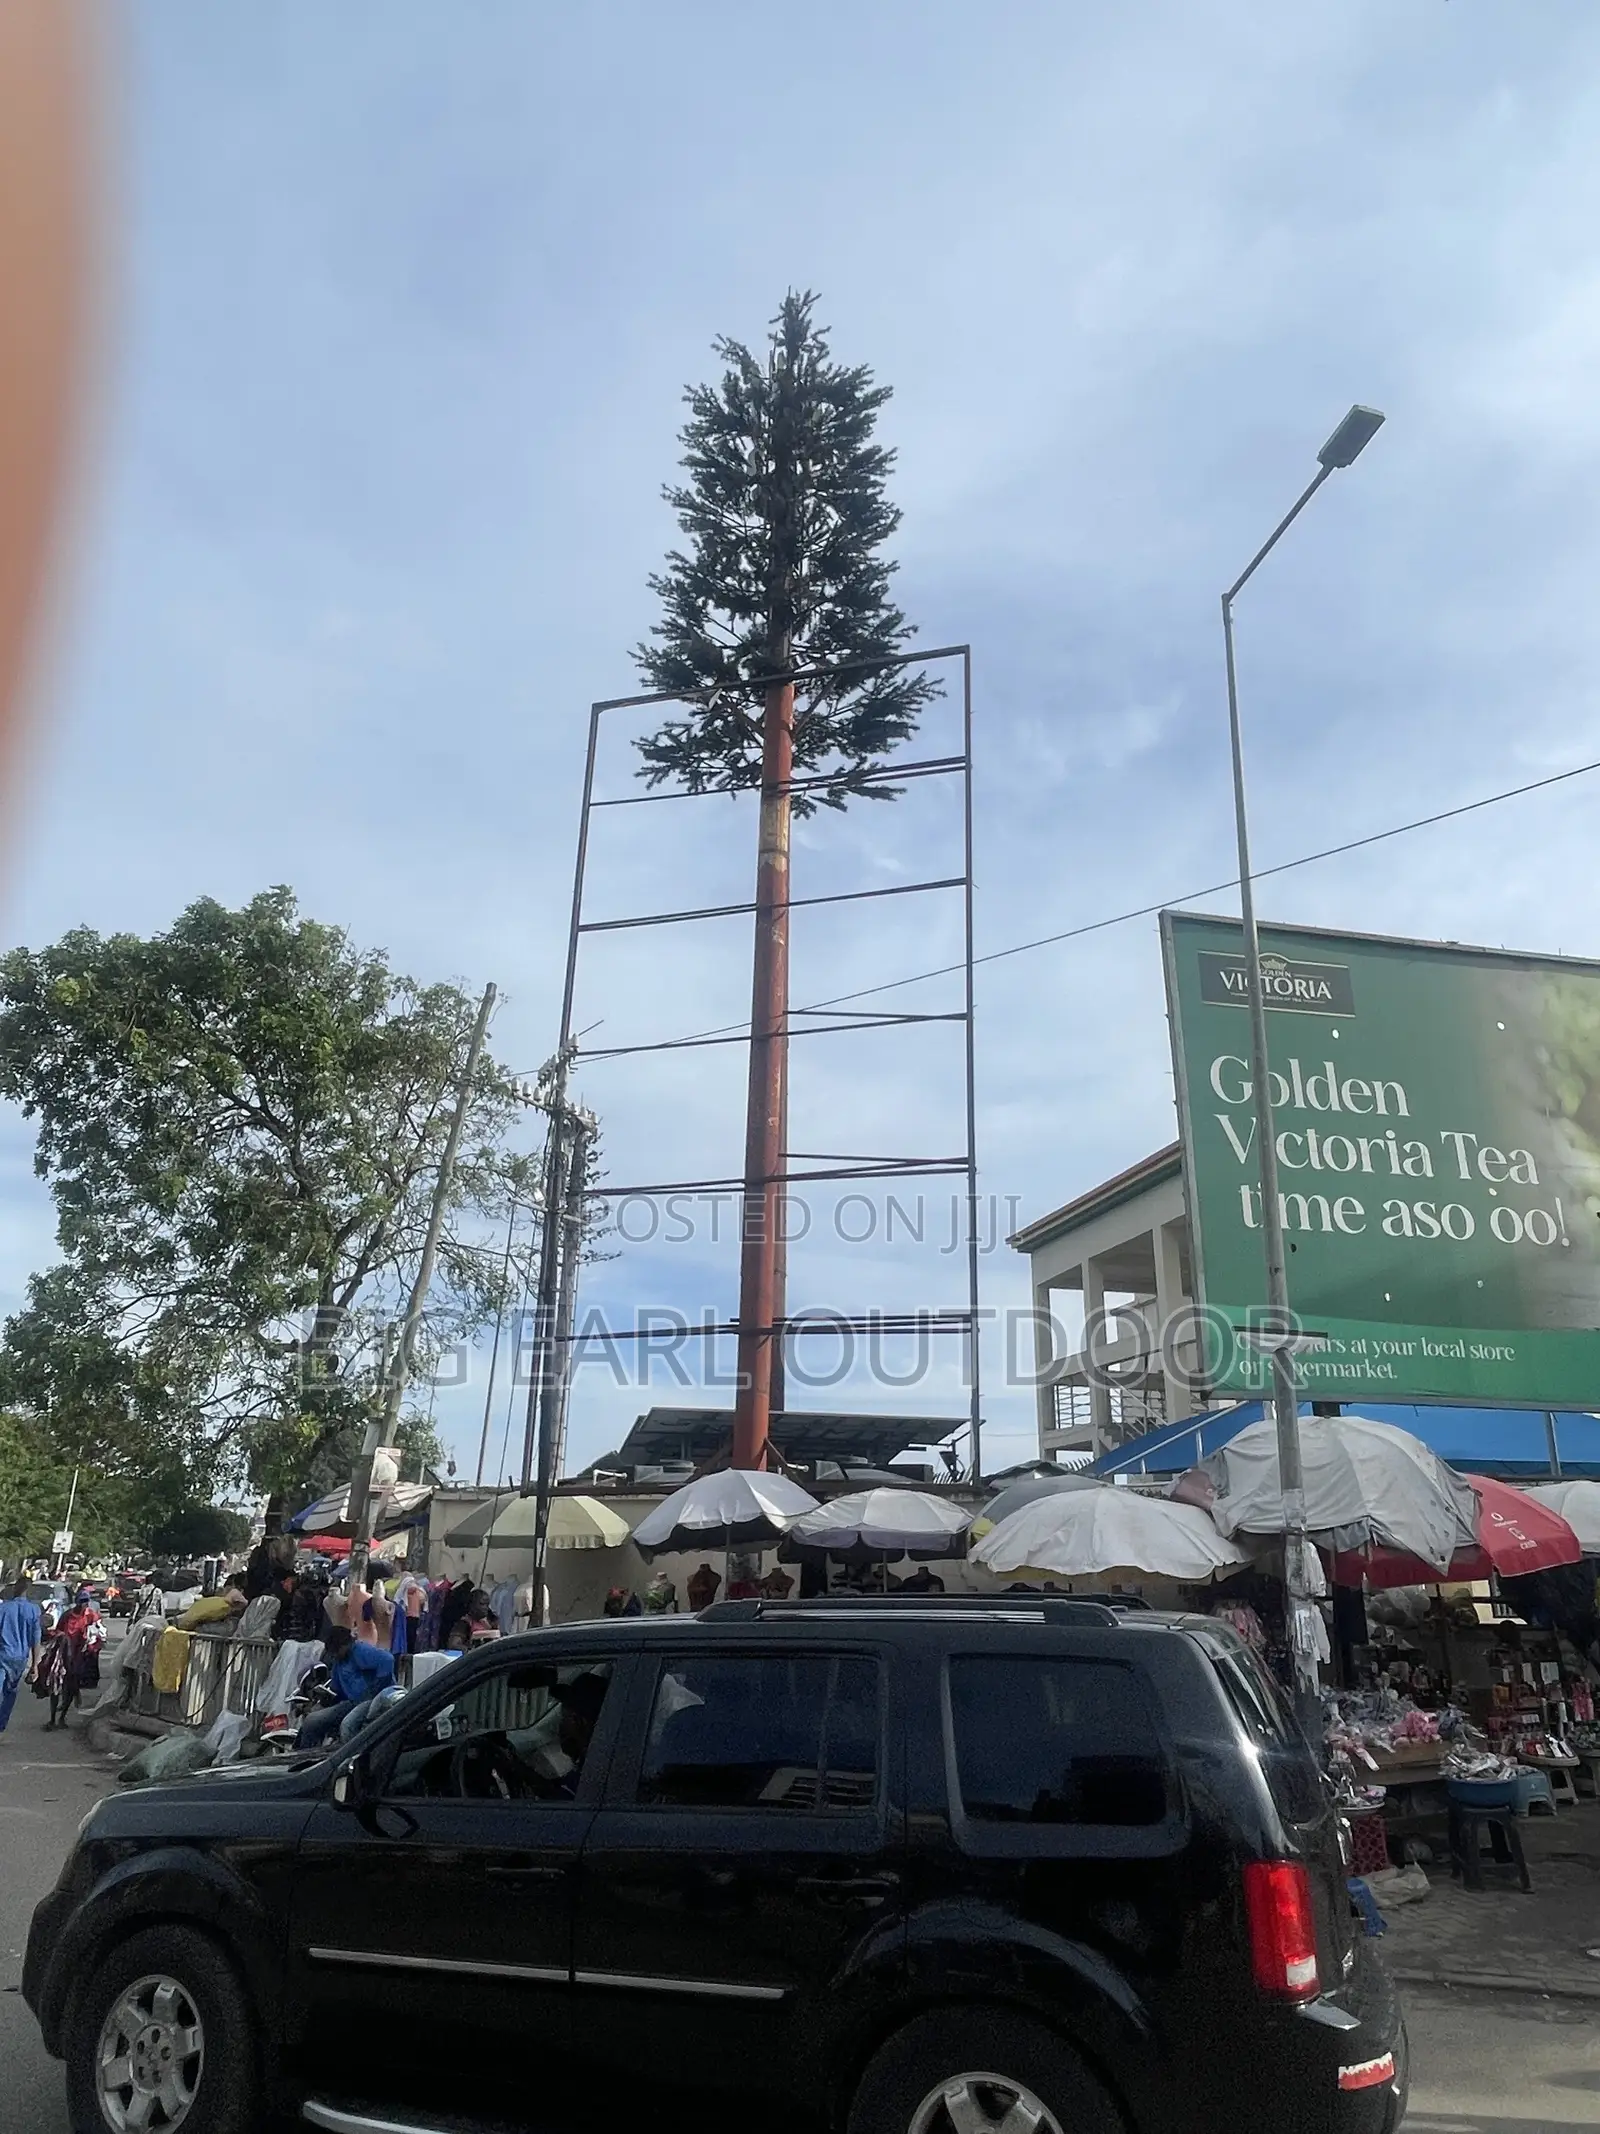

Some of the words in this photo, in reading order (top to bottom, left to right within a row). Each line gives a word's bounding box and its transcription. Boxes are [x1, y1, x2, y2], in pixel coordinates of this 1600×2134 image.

[1219, 971, 1332, 999] VITORIA
[1214, 1114, 1434, 1178] Vctoria
[1440, 1131, 1539, 1185] Tea
[1382, 1198, 1475, 1240] aso
[1351, 1337, 1367, 1355] at
[1368, 1339, 1417, 1358] your
[1421, 1336, 1466, 1358] local
[1469, 1342, 1516, 1362] store
